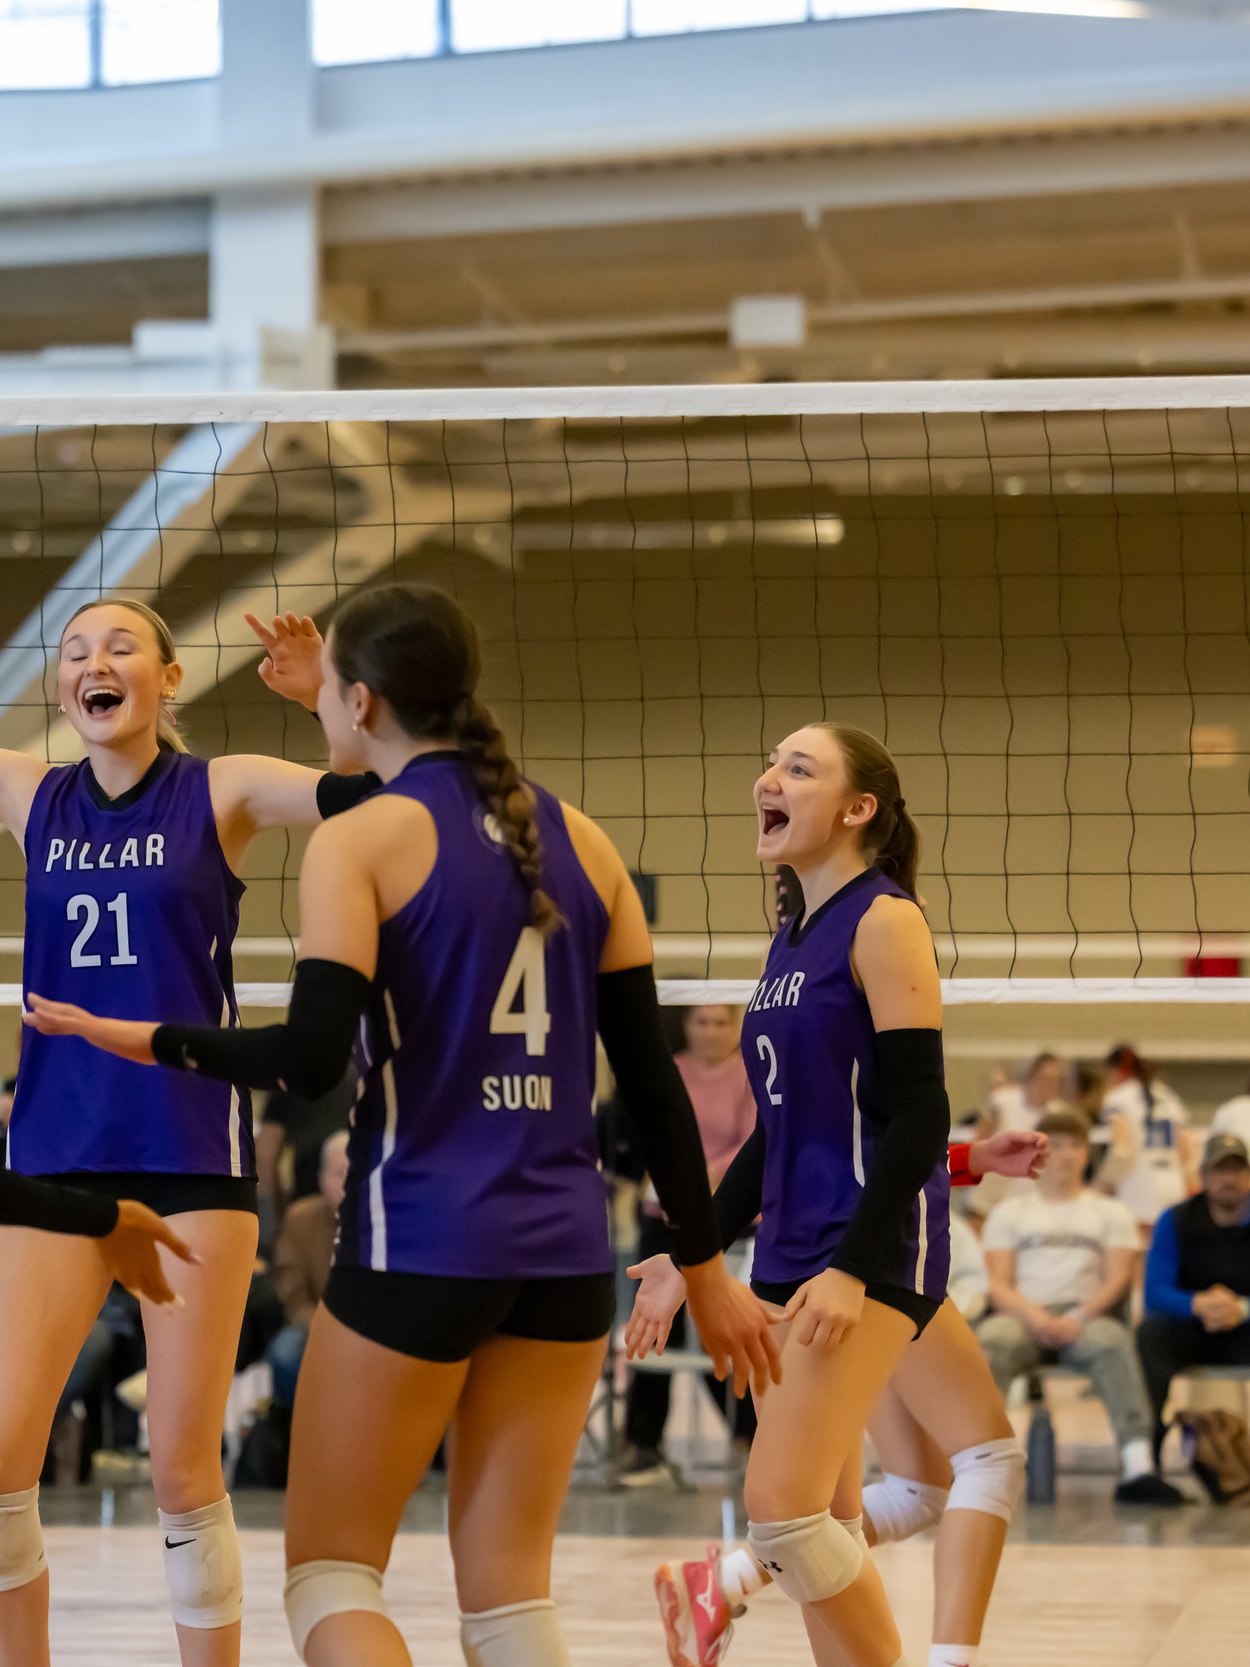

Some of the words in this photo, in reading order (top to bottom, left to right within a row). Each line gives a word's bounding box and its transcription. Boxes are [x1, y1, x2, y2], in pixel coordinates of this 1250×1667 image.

[45, 833, 165, 873] PILLAR
[66, 892, 138, 968] 21
[489, 925, 551, 1056] 4
[748, 971, 806, 1013] ILLAR
[756, 1034, 782, 1106] 2
